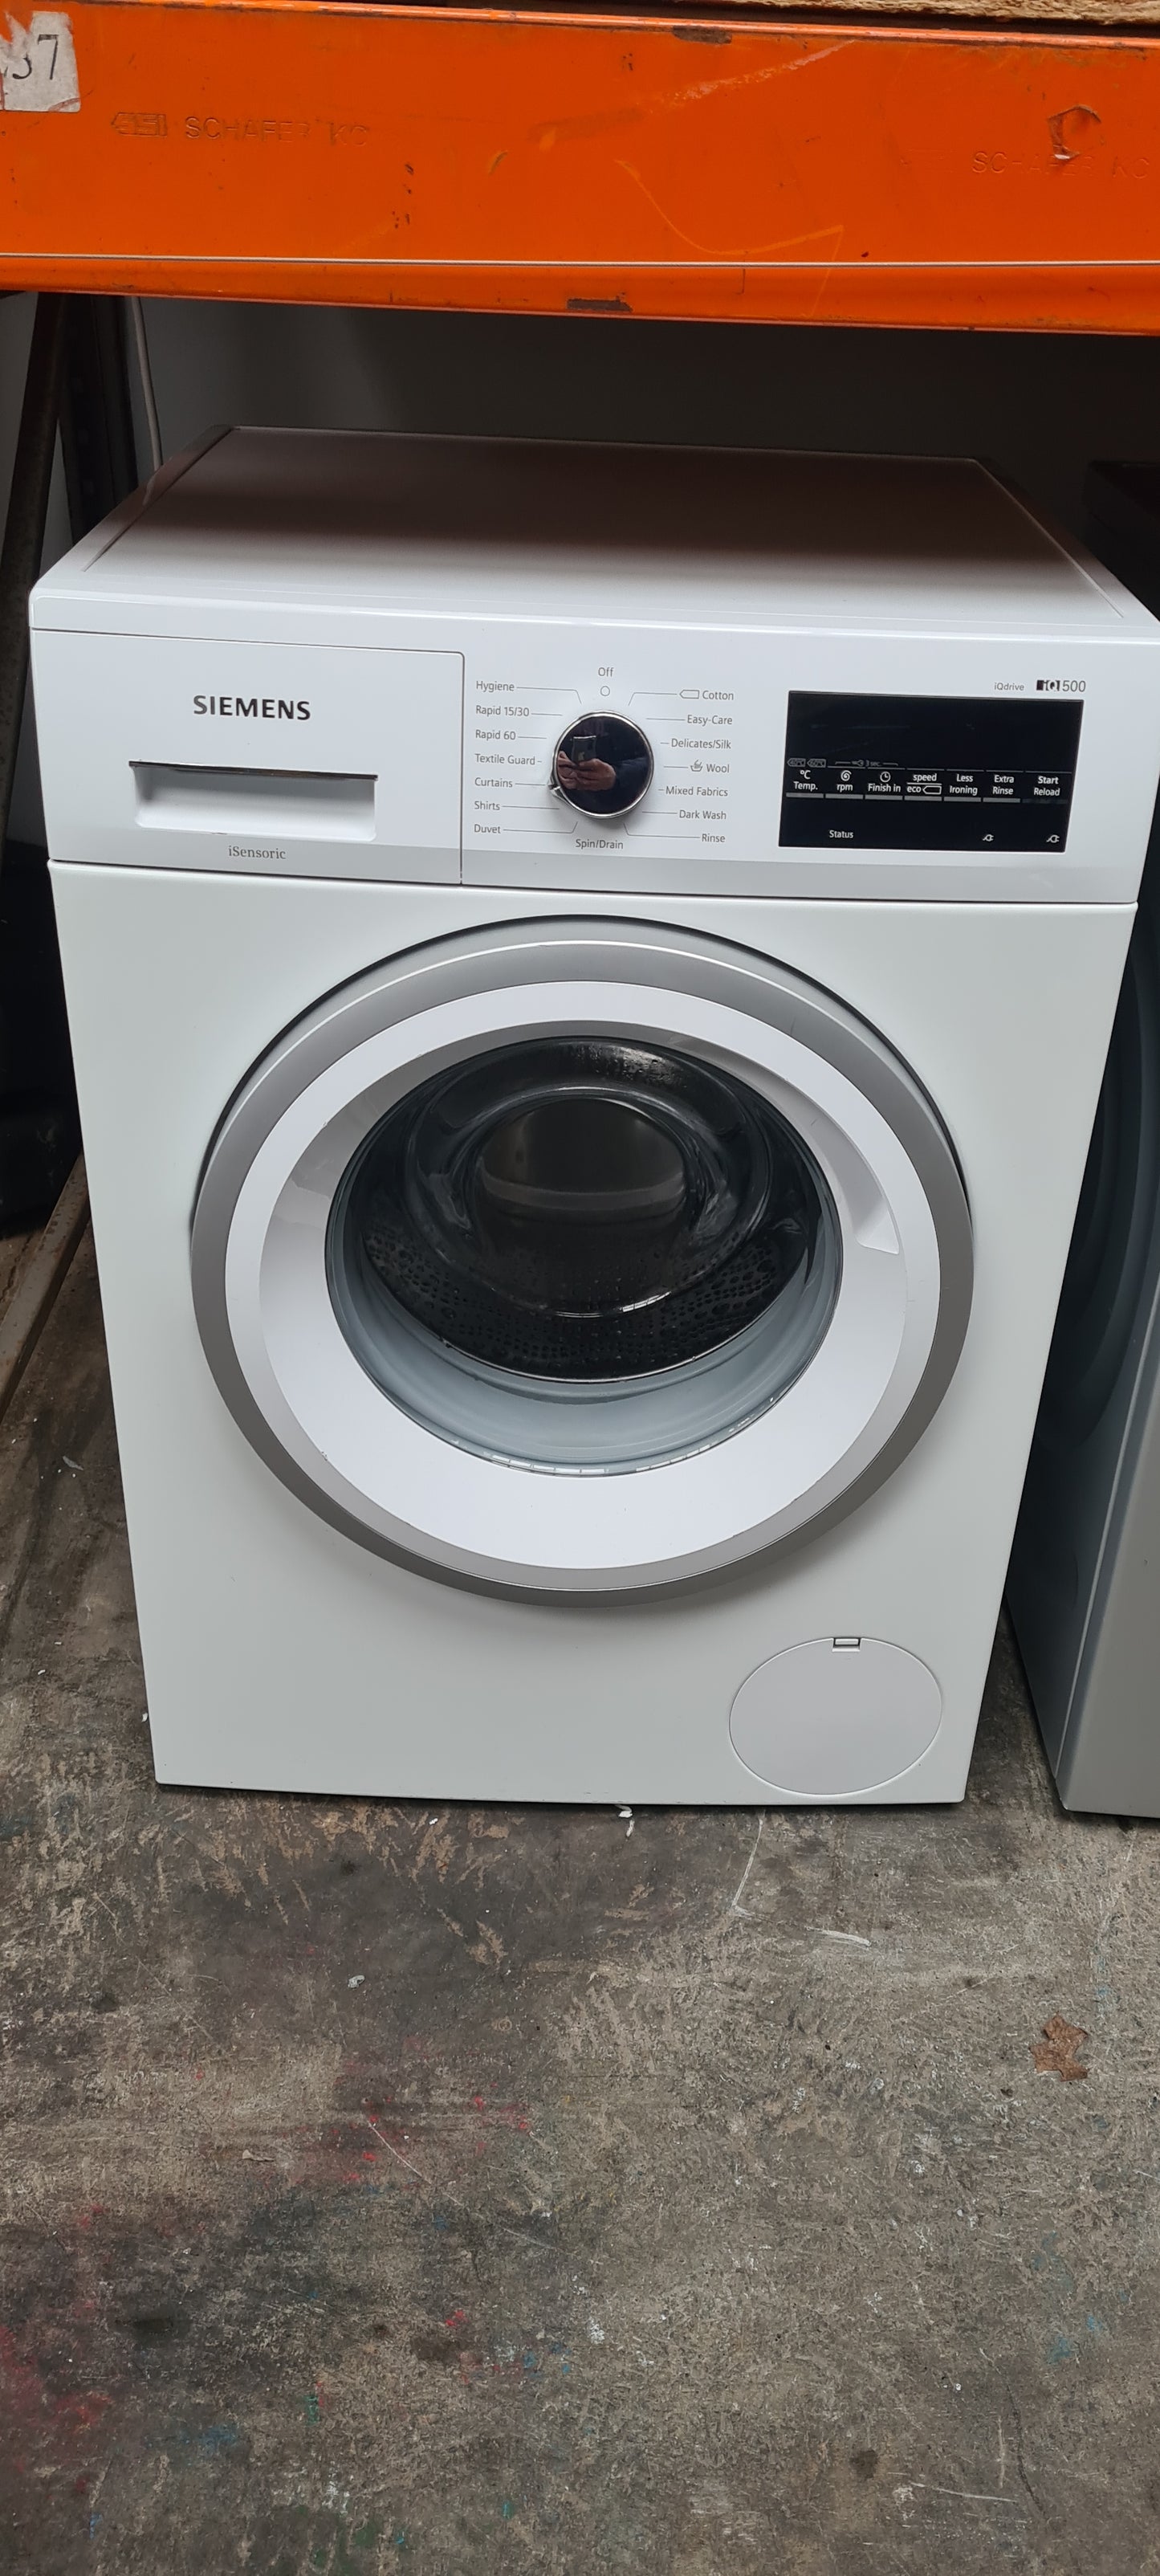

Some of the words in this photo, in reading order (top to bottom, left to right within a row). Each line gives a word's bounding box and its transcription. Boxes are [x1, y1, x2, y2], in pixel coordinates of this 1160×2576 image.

[598, 667, 614, 677] Off
[475, 680, 515, 692] Hygiene
[994, 682, 1024, 691] iQdrive
[1062, 679, 1086, 692] 500
[702, 690, 734, 700] Cotton
[193, 695, 311, 720] SIEMENS
[475, 705, 501, 717] Rapid
[504, 707, 530, 716] 15/30
[687, 714, 733, 727] Easy-Care
[475, 729, 501, 741] Rapid
[503, 731, 516, 740] 60
[671, 738, 731, 749] Delicates/Silk
[475, 753, 505, 764] Textile
[507, 755, 535, 765] Guard
[706, 764, 730, 773] Wool
[474, 777, 513, 788] Curtains
[913, 773, 937, 783] speed
[956, 774, 974, 782] Less
[994, 775, 1014, 784] Extra
[1038, 776, 1059, 785] Start
[665, 786, 694, 796] Mixed
[696, 786, 728, 797] Fabrics
[793, 781, 818, 793] Temp.
[836, 784, 853, 793] rpm
[868, 784, 891, 793] Finish
[893, 785, 902, 793] in
[950, 785, 978, 796] Ironing
[992, 787, 1014, 795] Rinse
[1033, 788, 1060, 797] Reload
[474, 801, 500, 811] Shirts
[679, 810, 700, 819] Dark
[702, 810, 727, 819] Wash
[474, 824, 501, 834] Duvet
[829, 829, 854, 838] Status
[702, 834, 726, 842] Rinse
[576, 839, 624, 850] Spin/Drain
[228, 846, 287, 860] iSensoric
